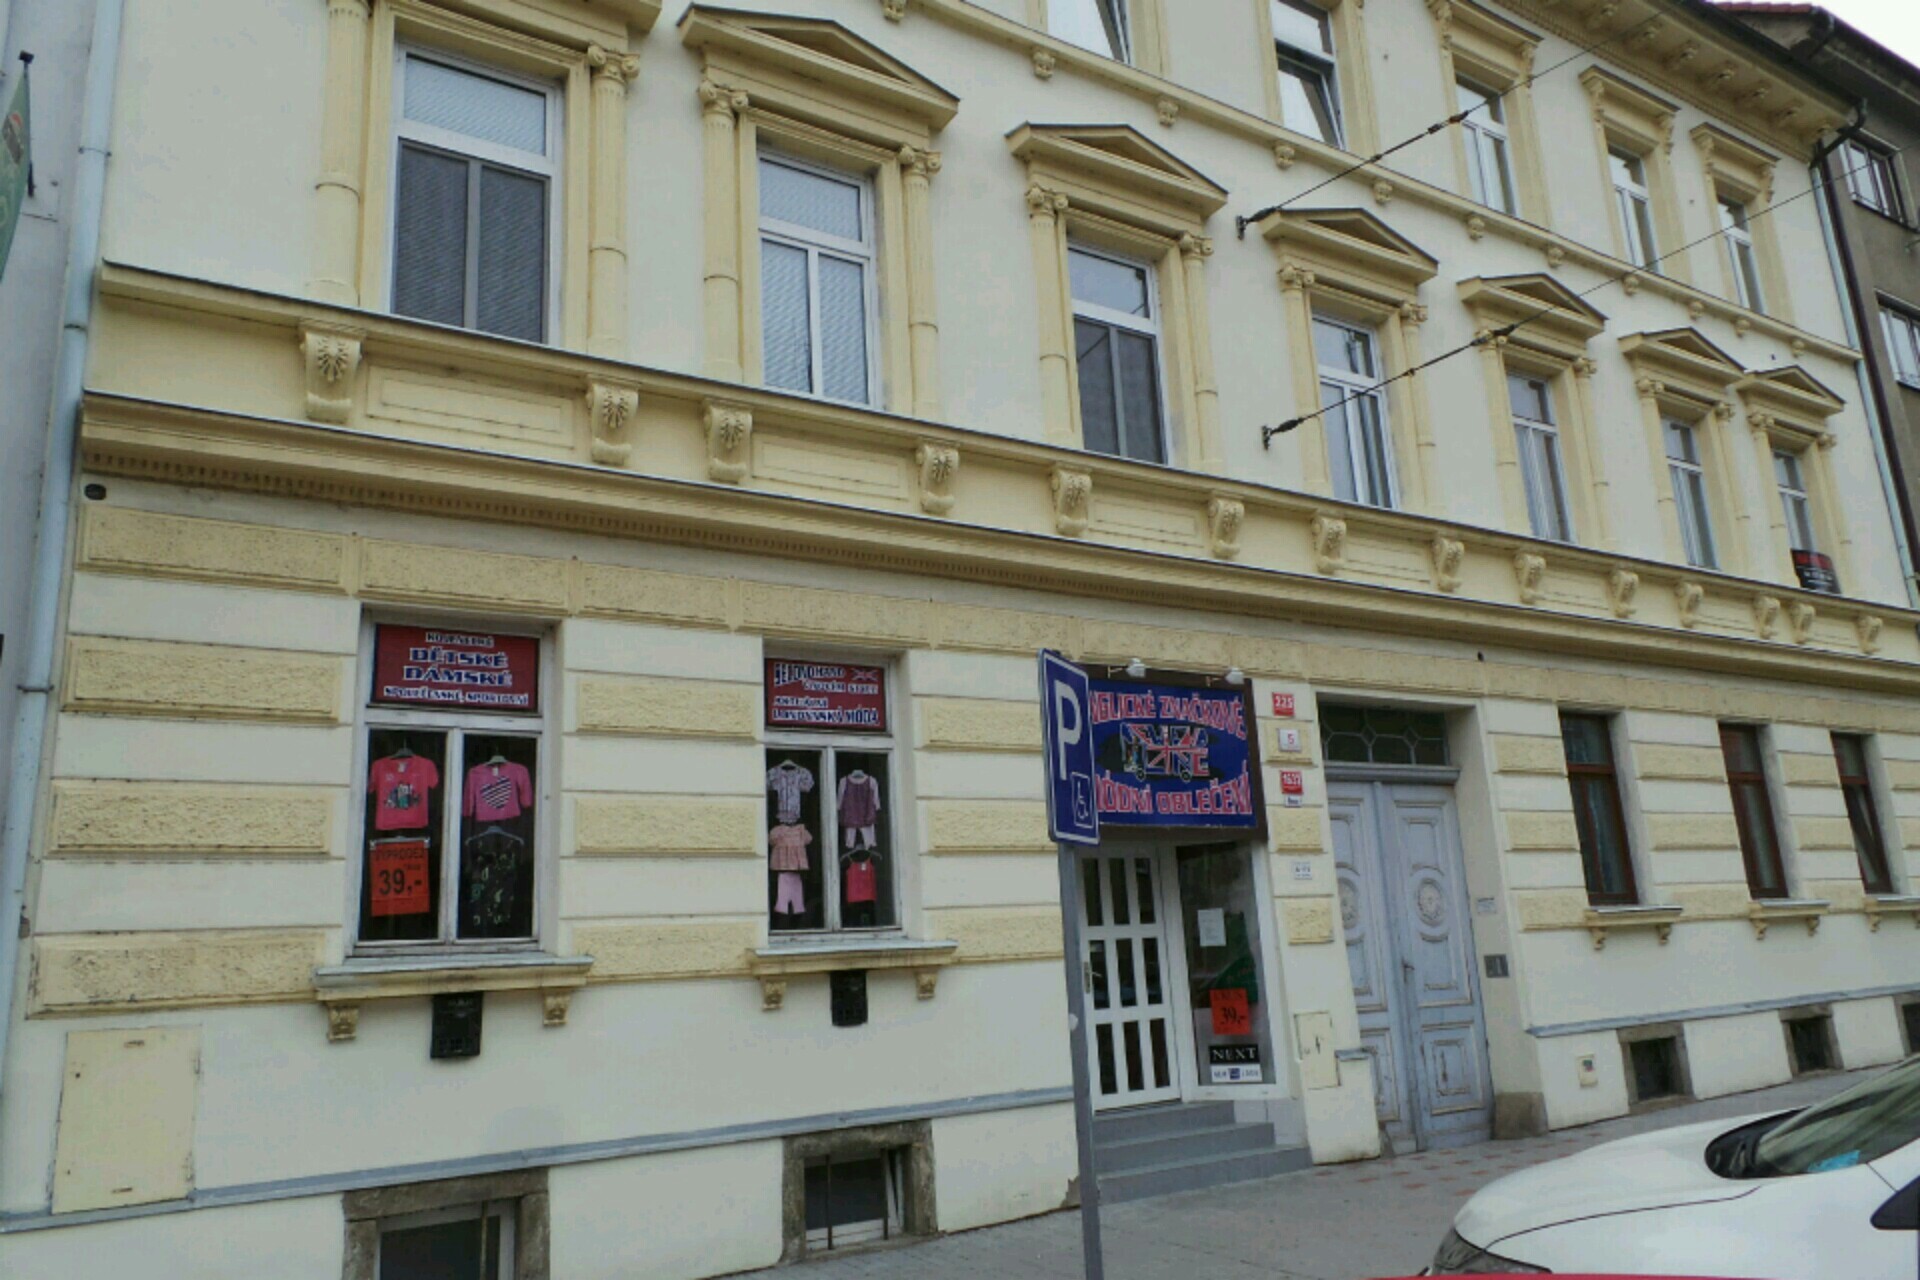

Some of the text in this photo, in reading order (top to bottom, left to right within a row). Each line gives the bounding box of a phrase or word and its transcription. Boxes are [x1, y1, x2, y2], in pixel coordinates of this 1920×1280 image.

[410, 646, 507, 668] DĚTSKÉ
[404, 664, 512, 686] DÁMSKÉ
[844, 704, 880, 726] MÓDA
[1089, 689, 1247, 741] NGLICKÉ ZNAČKOVÉ
[1054, 679, 1082, 781] P
[1155, 759, 1253, 816] OBLEČENÍ
[379, 868, 422, 895] 39,-
[1212, 1046, 1257, 1061] NEXT
